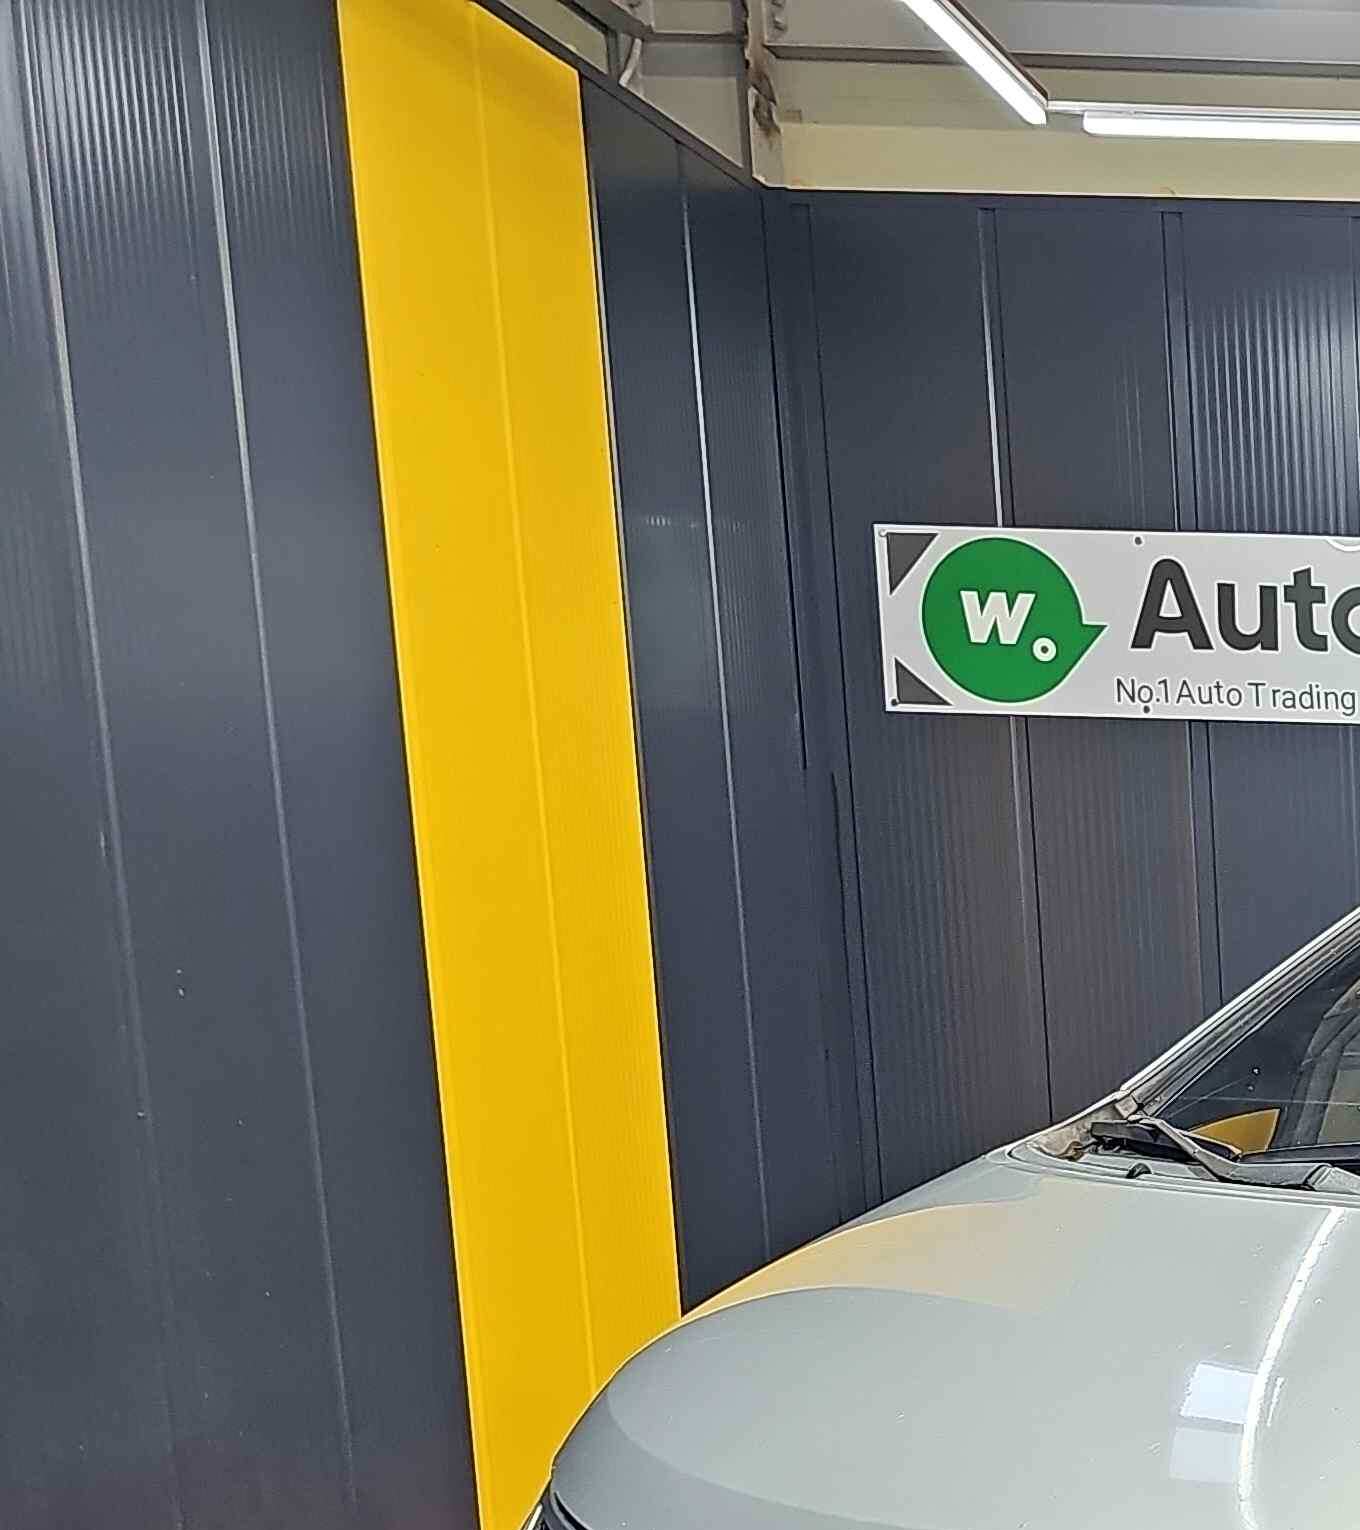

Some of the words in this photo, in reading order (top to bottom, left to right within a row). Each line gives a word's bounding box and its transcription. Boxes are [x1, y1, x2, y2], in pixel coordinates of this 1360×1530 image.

[1115, 677, 1170, 704] No.1
[1176, 679, 1242, 707] Auto
[1248, 682, 1356, 717] Trading
